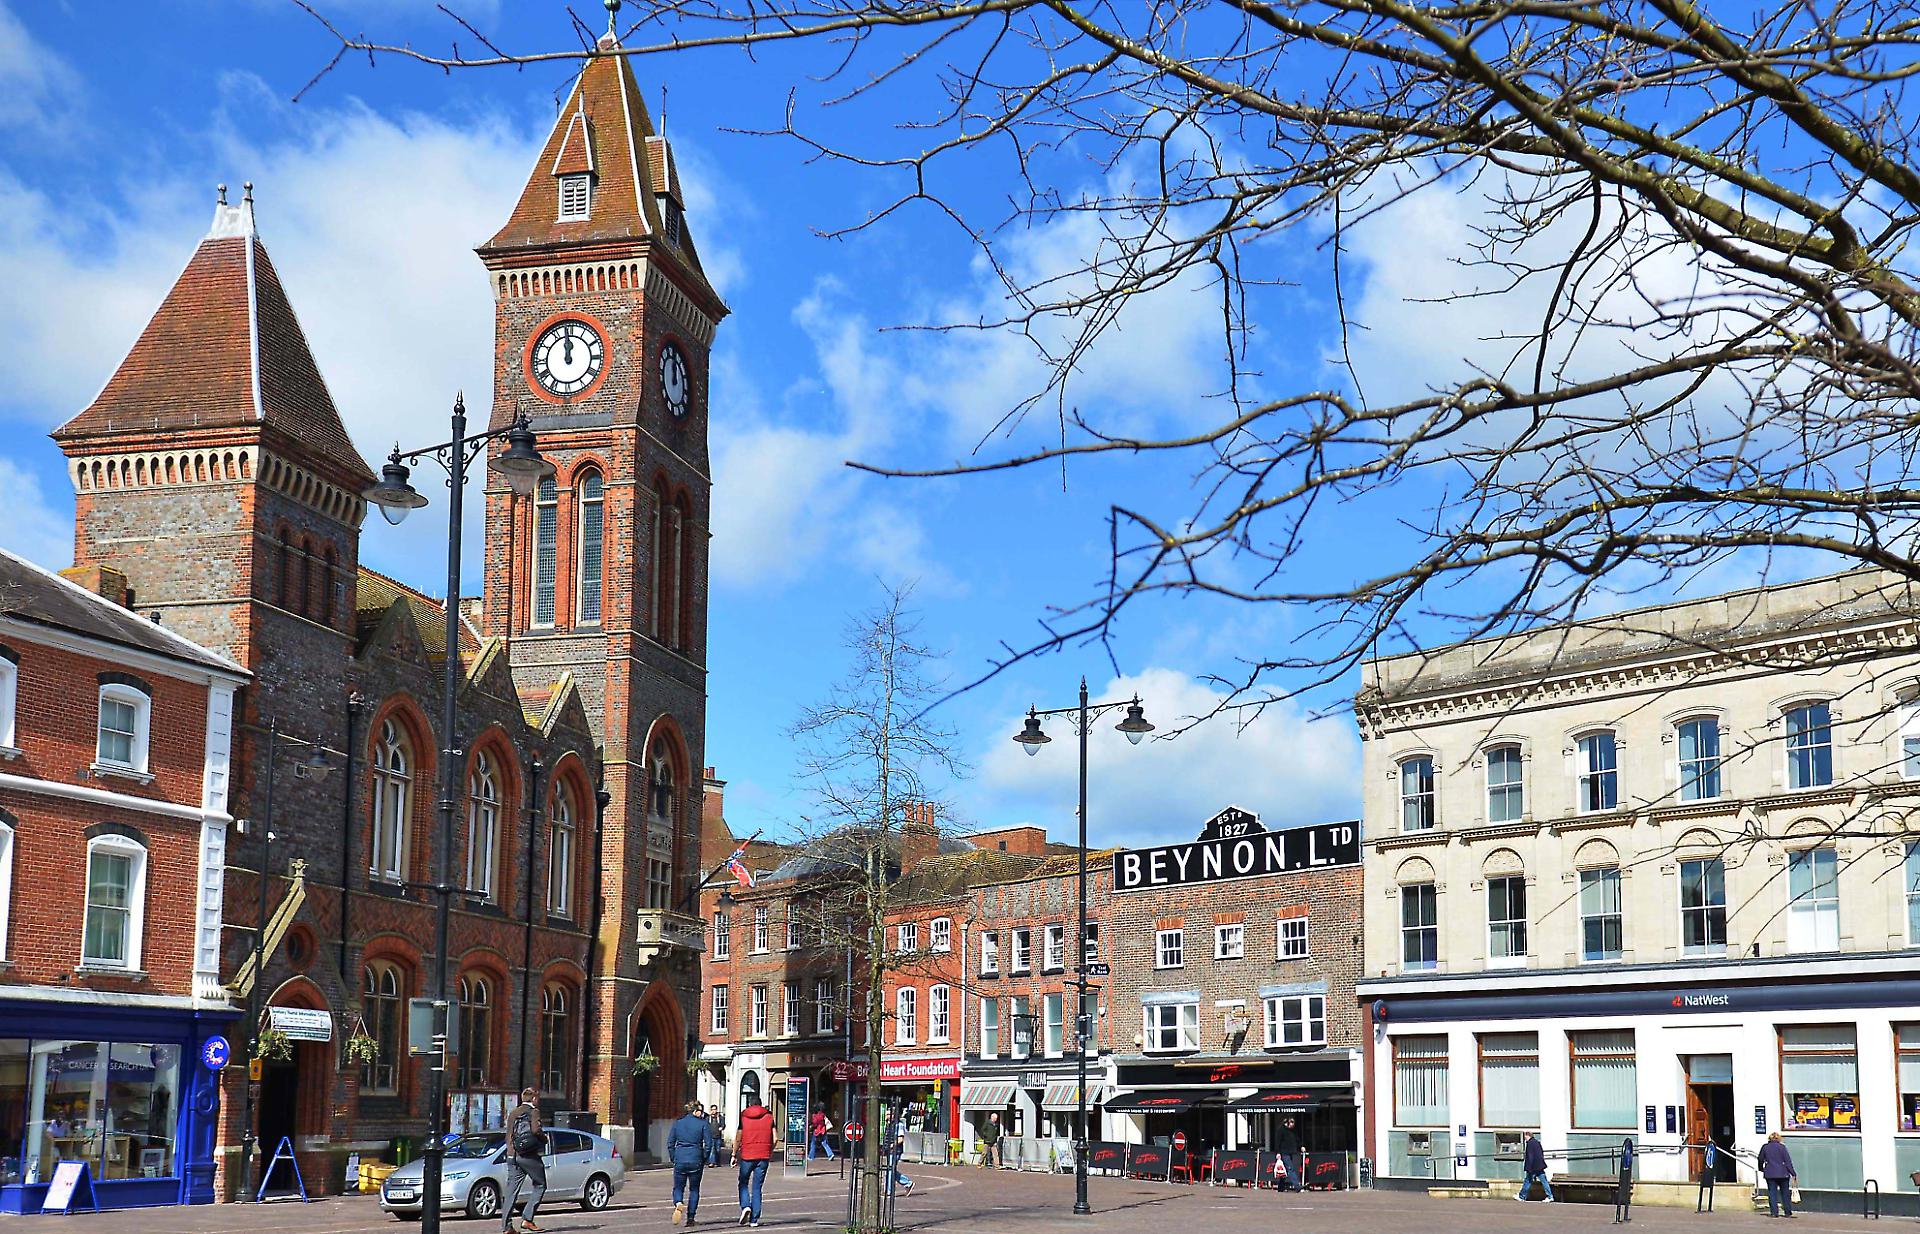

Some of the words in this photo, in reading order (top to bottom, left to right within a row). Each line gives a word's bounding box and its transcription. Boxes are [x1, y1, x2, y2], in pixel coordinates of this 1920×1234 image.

[1220, 822, 1248, 838] 1827
[1684, 994, 1728, 1006] NatWest
[101, 1062, 138, 1070] RSEARCH
[884, 1064, 906, 1076] Heart
[906, 1062, 954, 1076] Foundation
